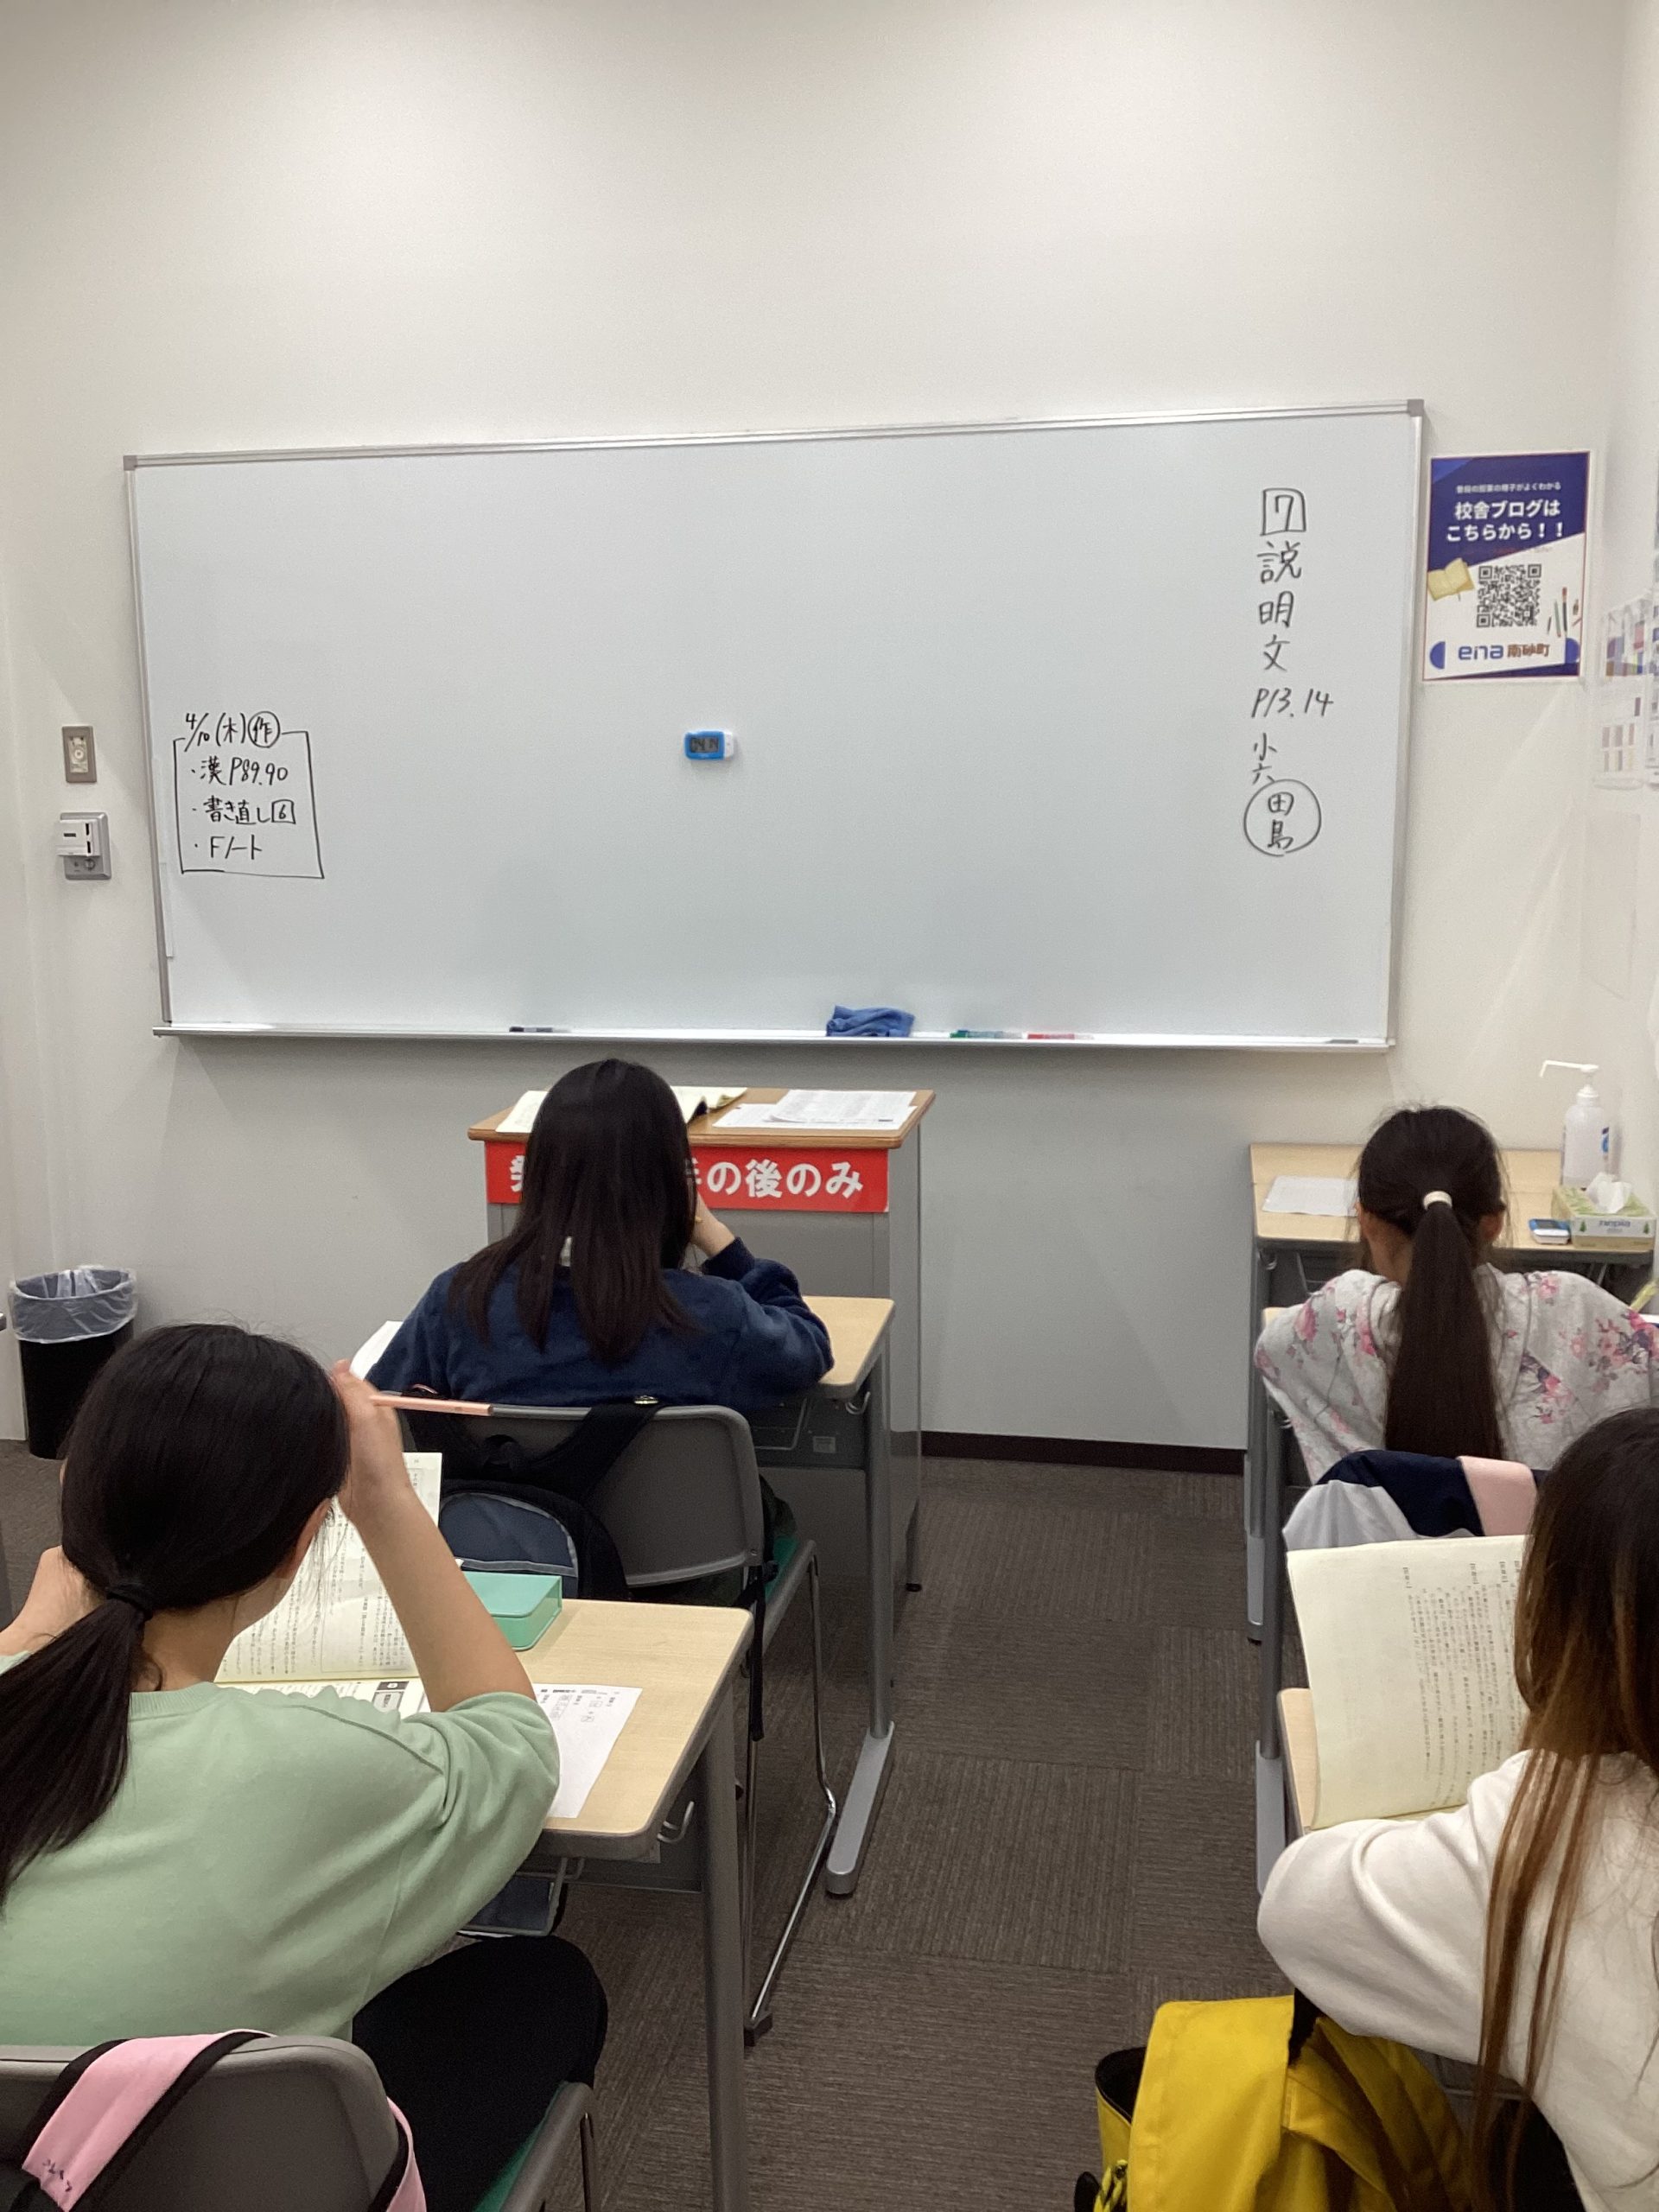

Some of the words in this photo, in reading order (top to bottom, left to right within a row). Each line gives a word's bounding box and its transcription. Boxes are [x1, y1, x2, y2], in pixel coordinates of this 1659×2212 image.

[1454, 499, 1561, 520] 校舎ブログは
[1256, 540, 1302, 672] 説明文
[1458, 645, 1504, 660] ena
